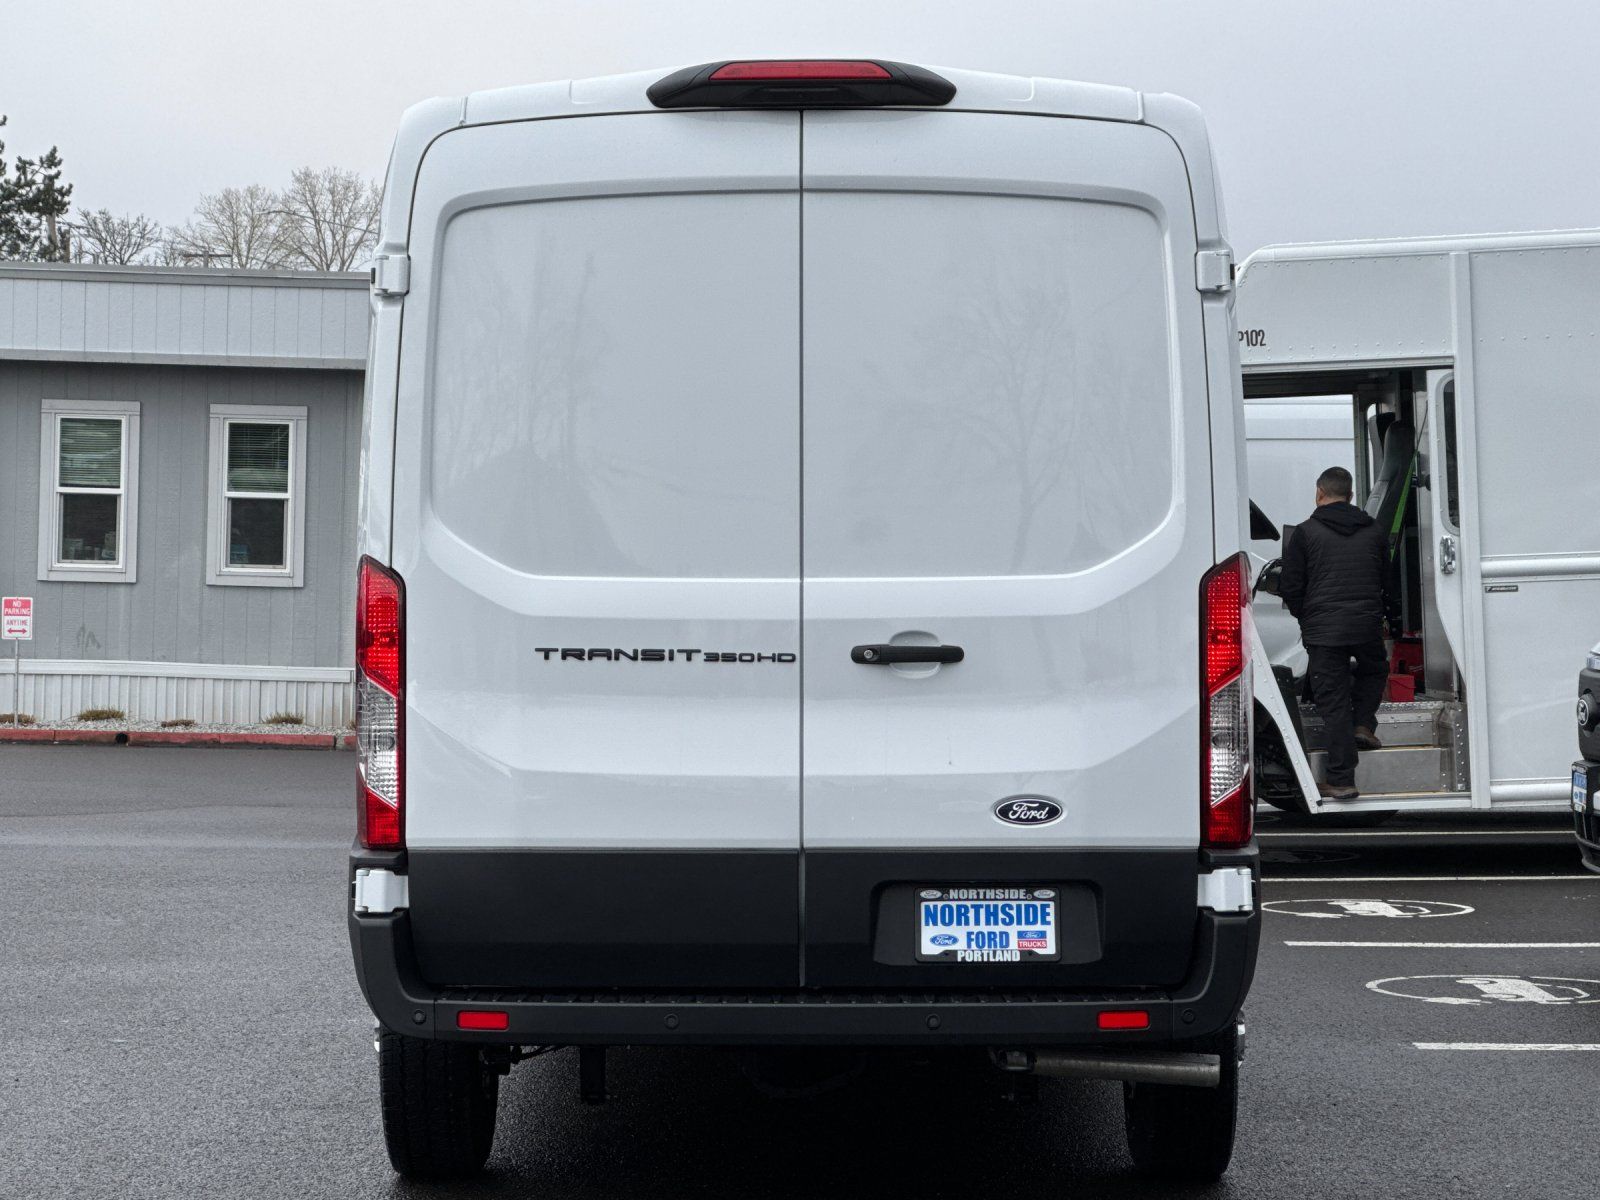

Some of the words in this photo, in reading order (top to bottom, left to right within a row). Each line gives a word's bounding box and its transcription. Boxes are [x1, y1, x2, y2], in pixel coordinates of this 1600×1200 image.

[534, 647, 702, 662] TRANSIT
[703, 652, 797, 663] 350HD
[1008, 802, 1049, 819] Ford
[949, 888, 1027, 900] NORTHSIDE
[924, 903, 1051, 926] NORTHSIDE
[966, 931, 1010, 949] FORD
[1018, 940, 1047, 948] TRUCKS
[957, 950, 1021, 962] PORTLAND
